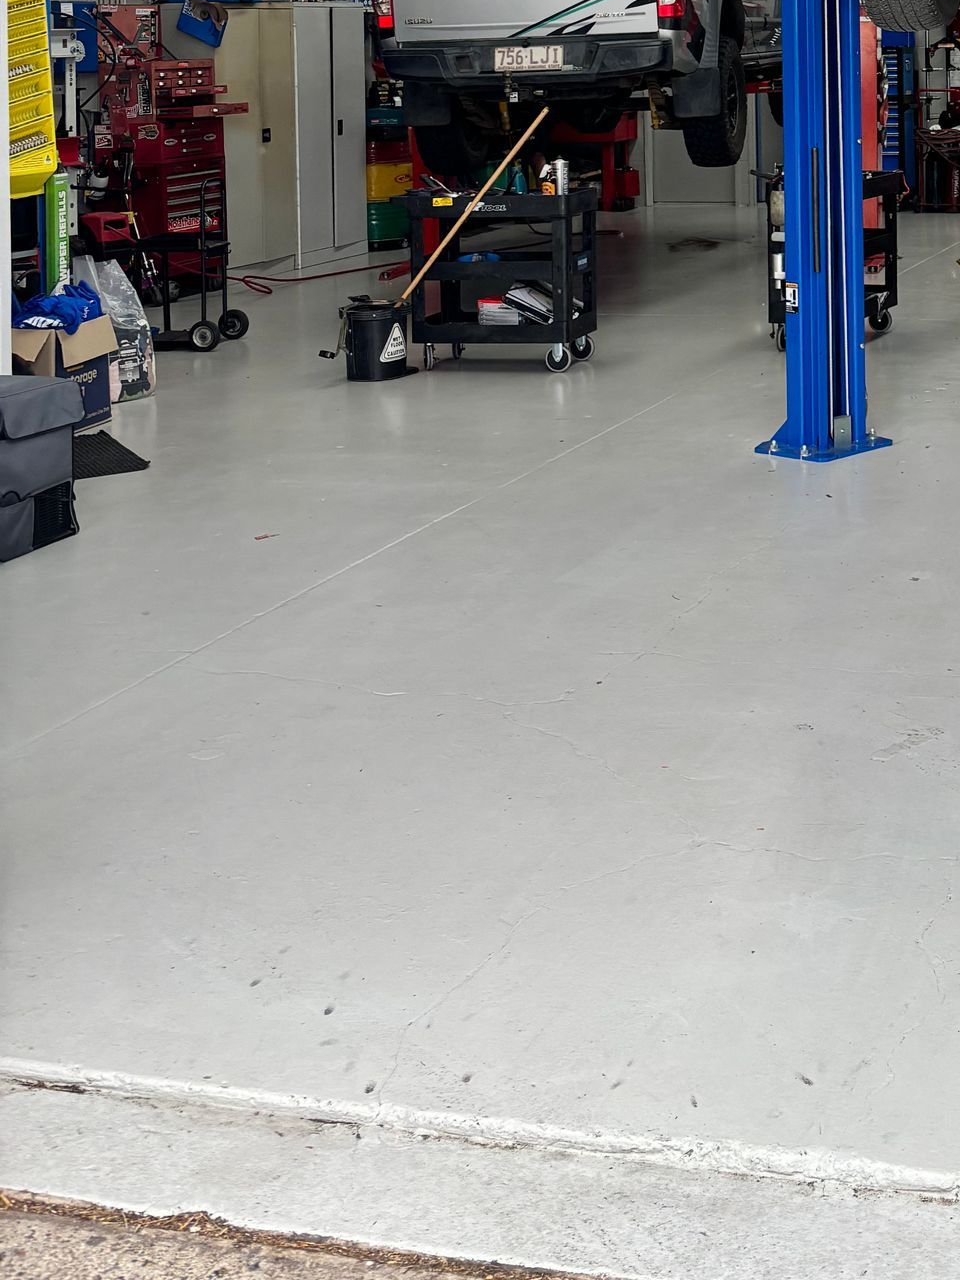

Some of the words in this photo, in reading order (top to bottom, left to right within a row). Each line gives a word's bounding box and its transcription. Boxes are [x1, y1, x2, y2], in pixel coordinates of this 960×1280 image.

[58, 190, 67, 239] REFILLS
[59, 240, 68, 283] WIPER
[70, 369, 98, 383] torage
